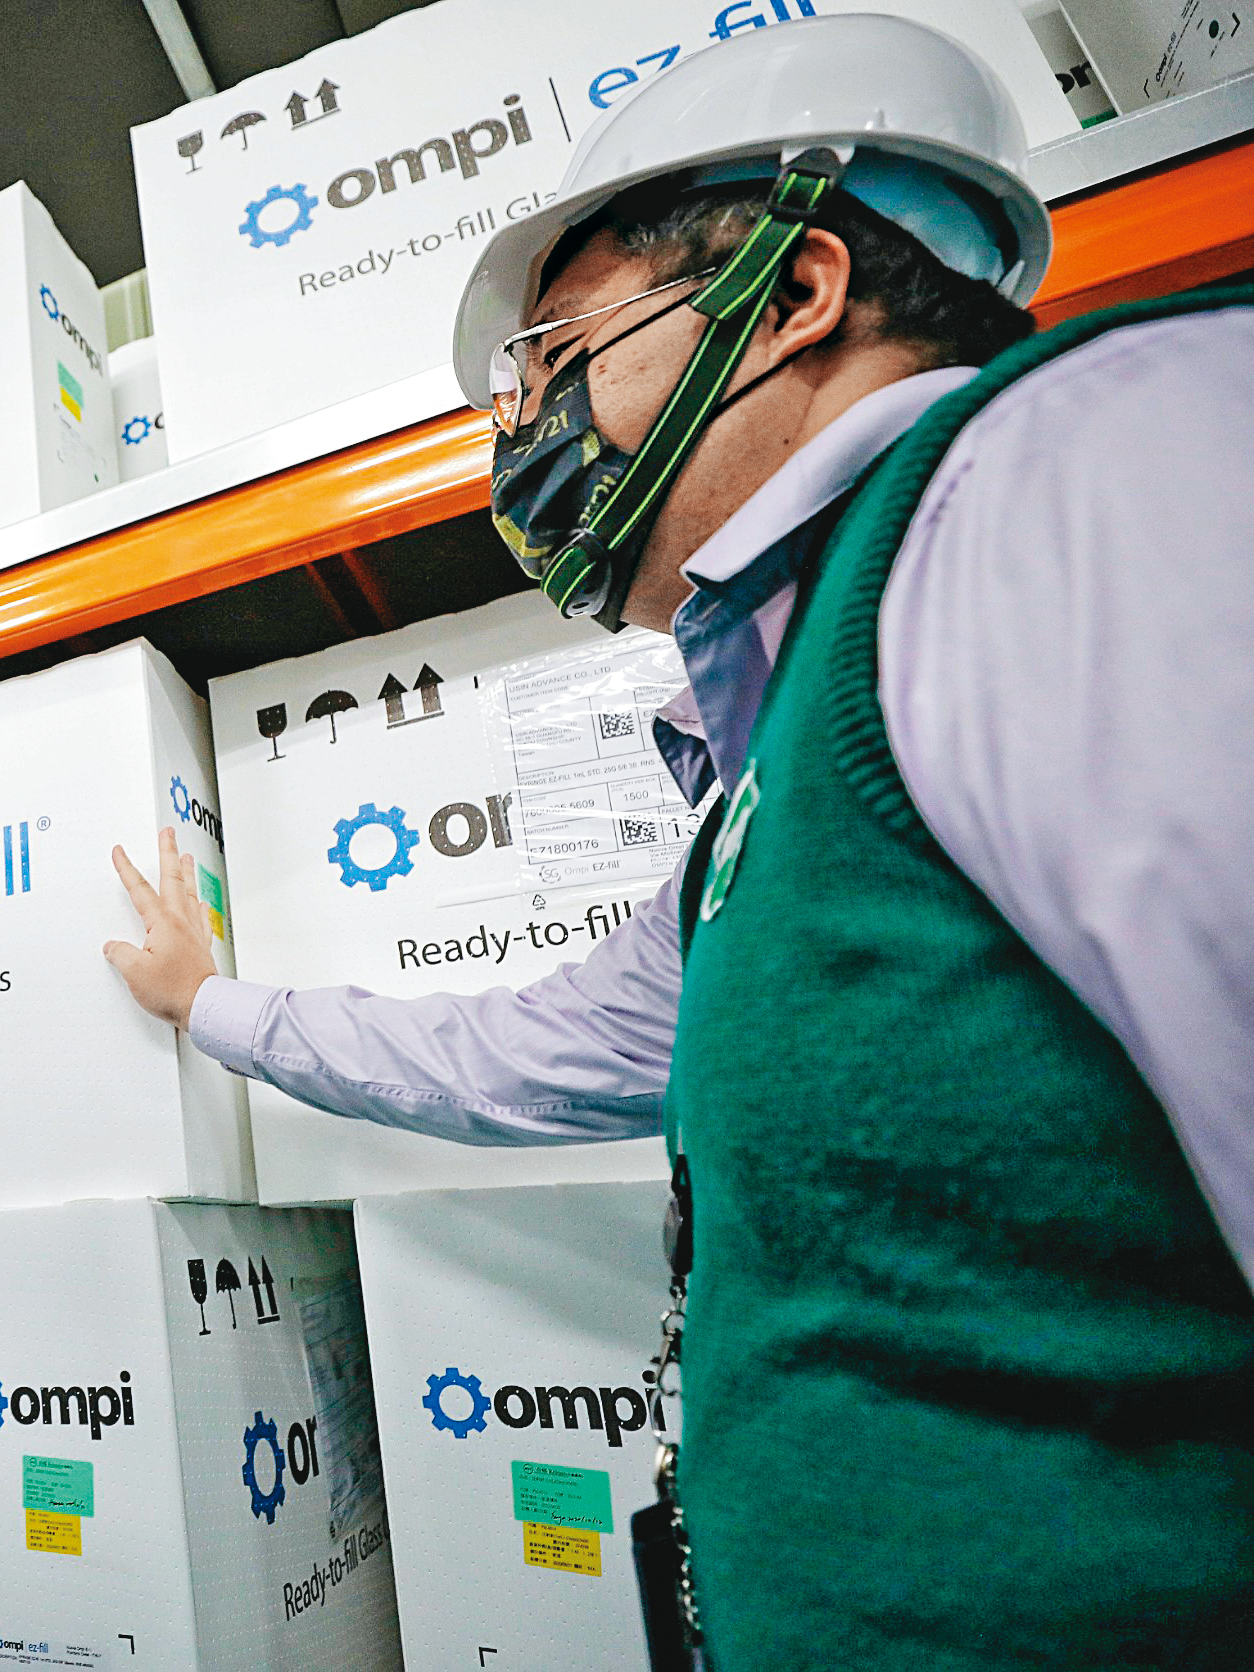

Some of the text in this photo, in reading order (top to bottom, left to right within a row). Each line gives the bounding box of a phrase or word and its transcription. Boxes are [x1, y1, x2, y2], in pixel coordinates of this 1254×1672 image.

[327, 93, 533, 209] ompi
[298, 213, 497, 296] Ready-to-fill
[61, 312, 104, 378] ompi
[531, 675, 572, 689] ADVANCE
[191, 797, 225, 854] omp
[623, 790, 649, 801] 1500
[10, 1370, 134, 1440] ompi
[494, 1369, 666, 1448] ompi
[283, 1535, 358, 1621] Ready-to-fill
